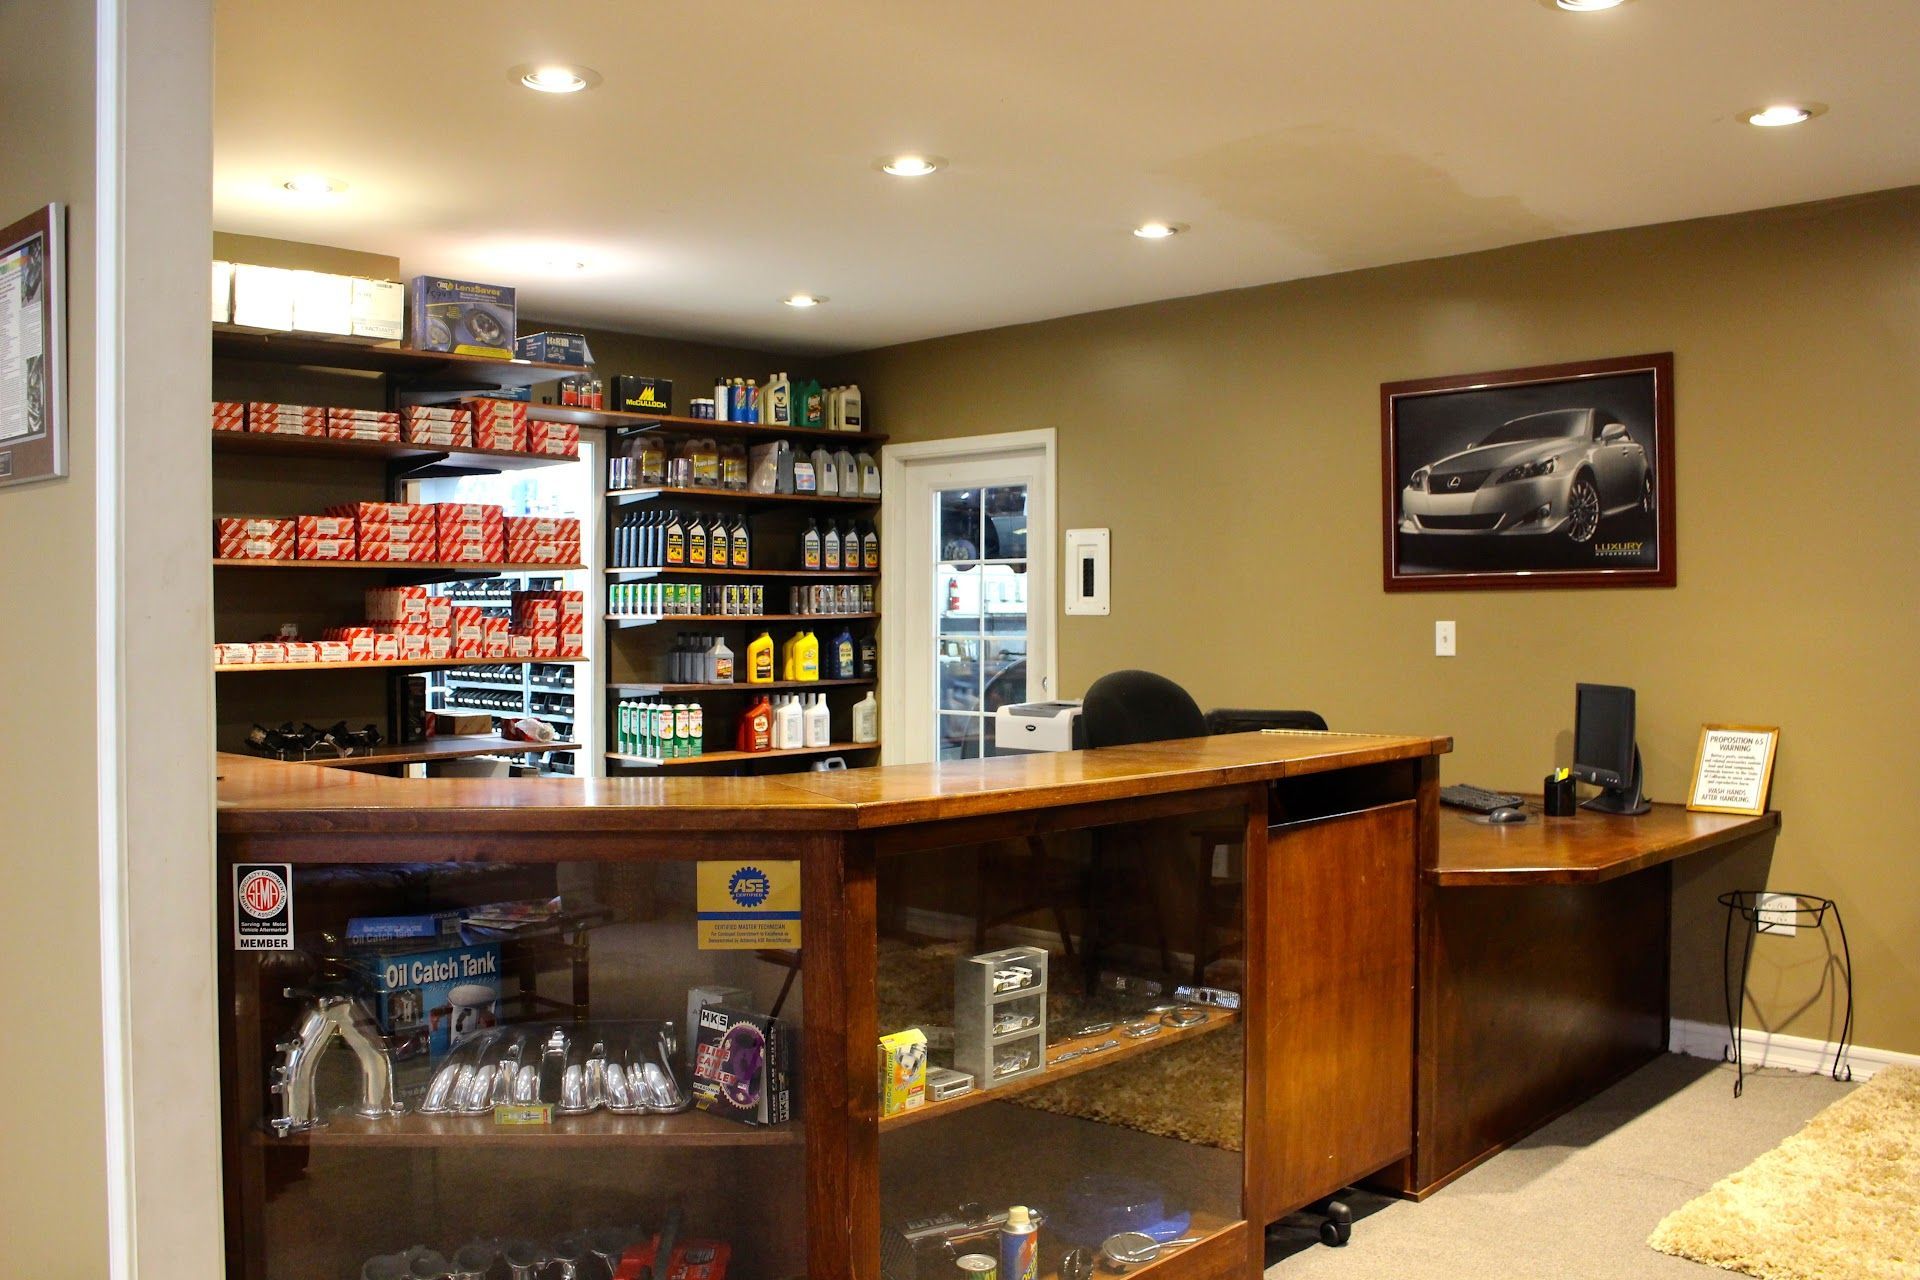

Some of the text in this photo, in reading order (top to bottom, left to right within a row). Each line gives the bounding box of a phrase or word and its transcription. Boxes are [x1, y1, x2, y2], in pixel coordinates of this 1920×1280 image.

[626, 399, 667, 408] McCULLOCH
[1595, 542, 1643, 551] LUXURY
[1710, 736, 1754, 745] PROPOSITION
[1720, 744, 1751, 752] WARNING
[240, 871, 285, 893] SPECIALTY EQUIPMENT
[733, 879, 764, 893] ASE
[248, 879, 279, 910] SEMA
[241, 895, 256, 915] MARKET
[240, 939, 288, 948] MEMBER
[352, 934, 364, 945] Oil
[386, 963, 408, 988] Oil
[412, 956, 459, 984] Catch
[460, 951, 497, 977] Tank
[702, 1011, 728, 1027] HKS
[780, 1091, 789, 1121] HKS
